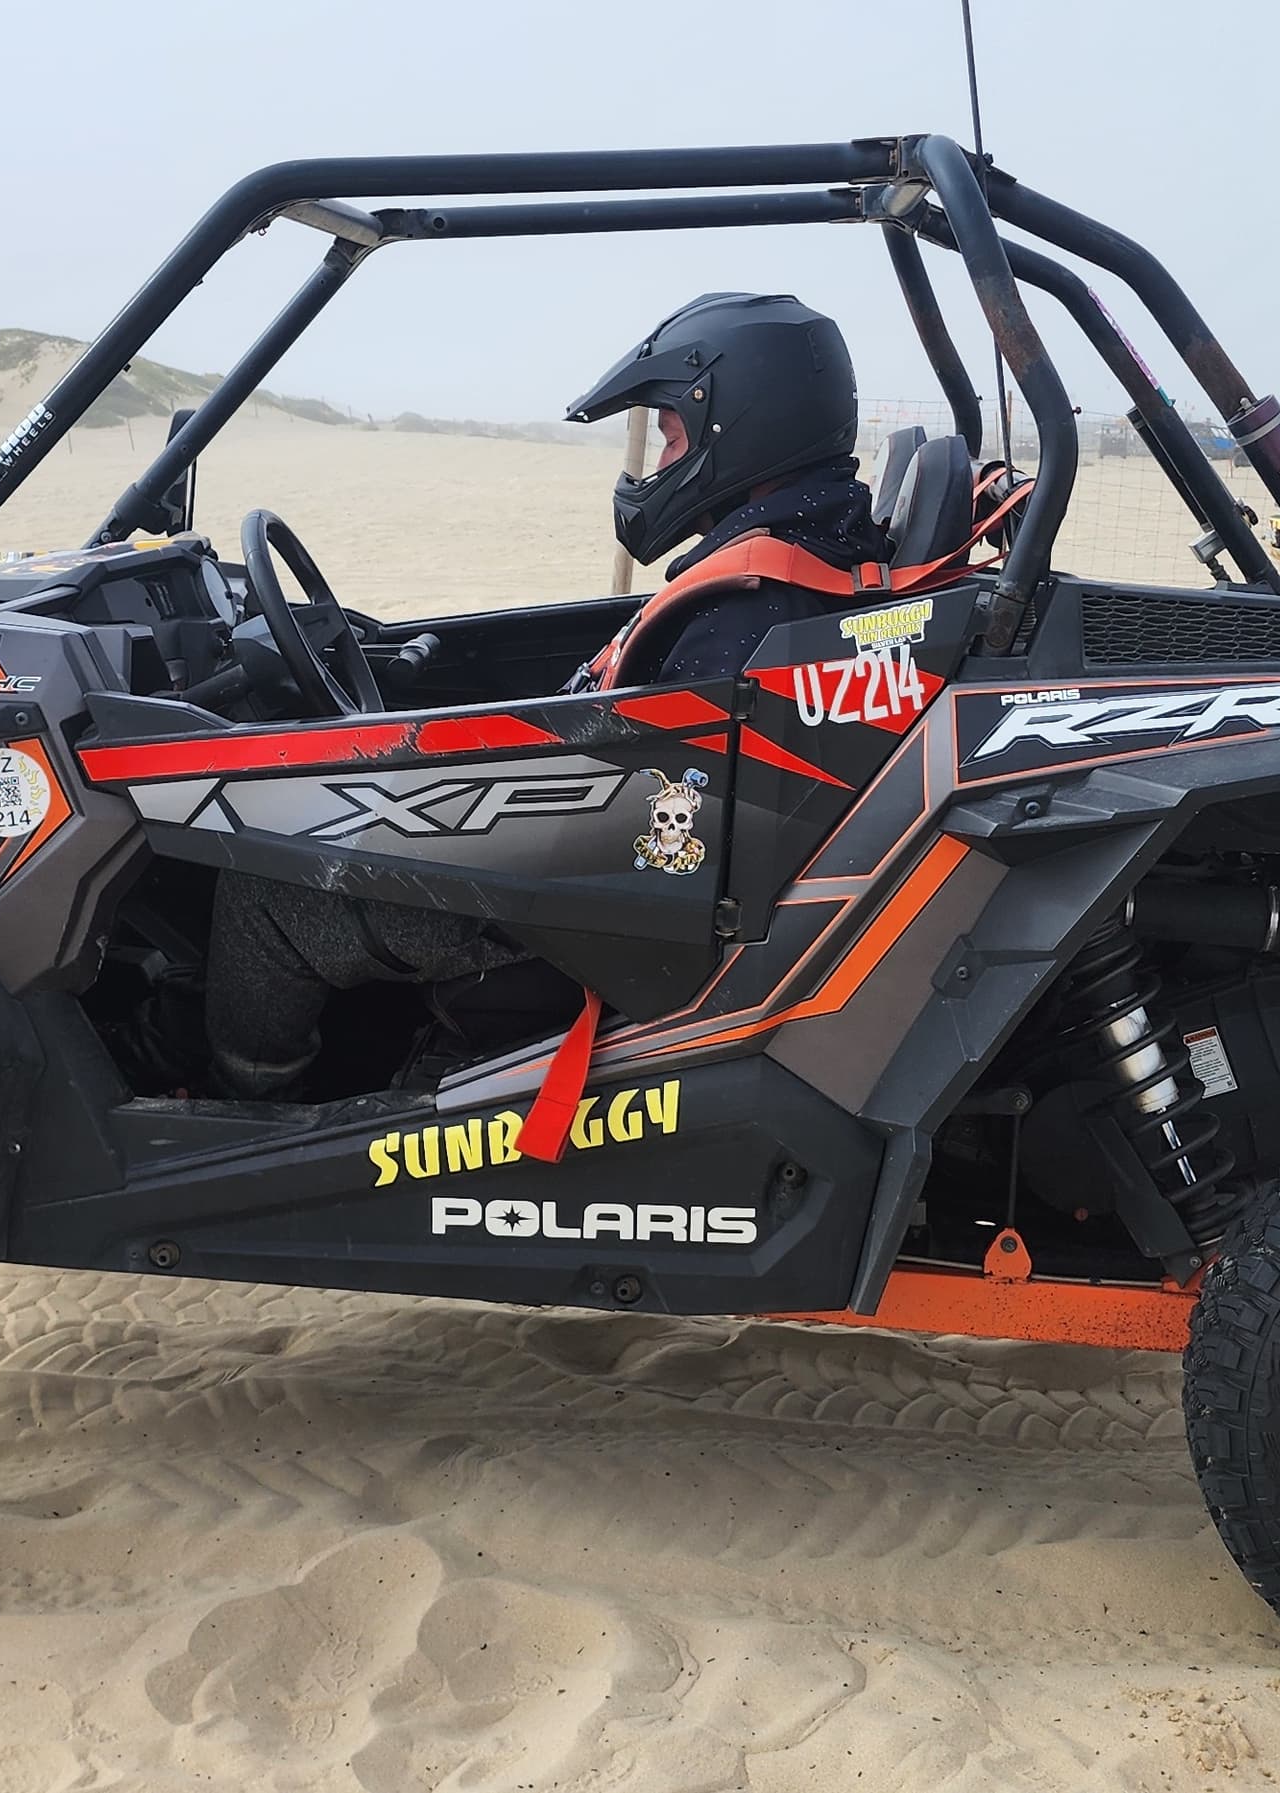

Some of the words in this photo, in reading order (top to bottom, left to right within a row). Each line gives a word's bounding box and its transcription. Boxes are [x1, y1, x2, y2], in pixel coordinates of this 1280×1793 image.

[2, 411, 53, 467] WHEELS
[841, 600, 931, 637] SUNBUGGY
[858, 630, 878, 645] FUN
[880, 621, 922, 640] RENTALS
[793, 644, 925, 727] UZ214
[1001, 688, 1081, 706] POLARIS
[307, 774, 626, 836] XP
[368, 1079, 681, 1188] SUNBGGY
[431, 1196, 759, 1244] POLARIS
